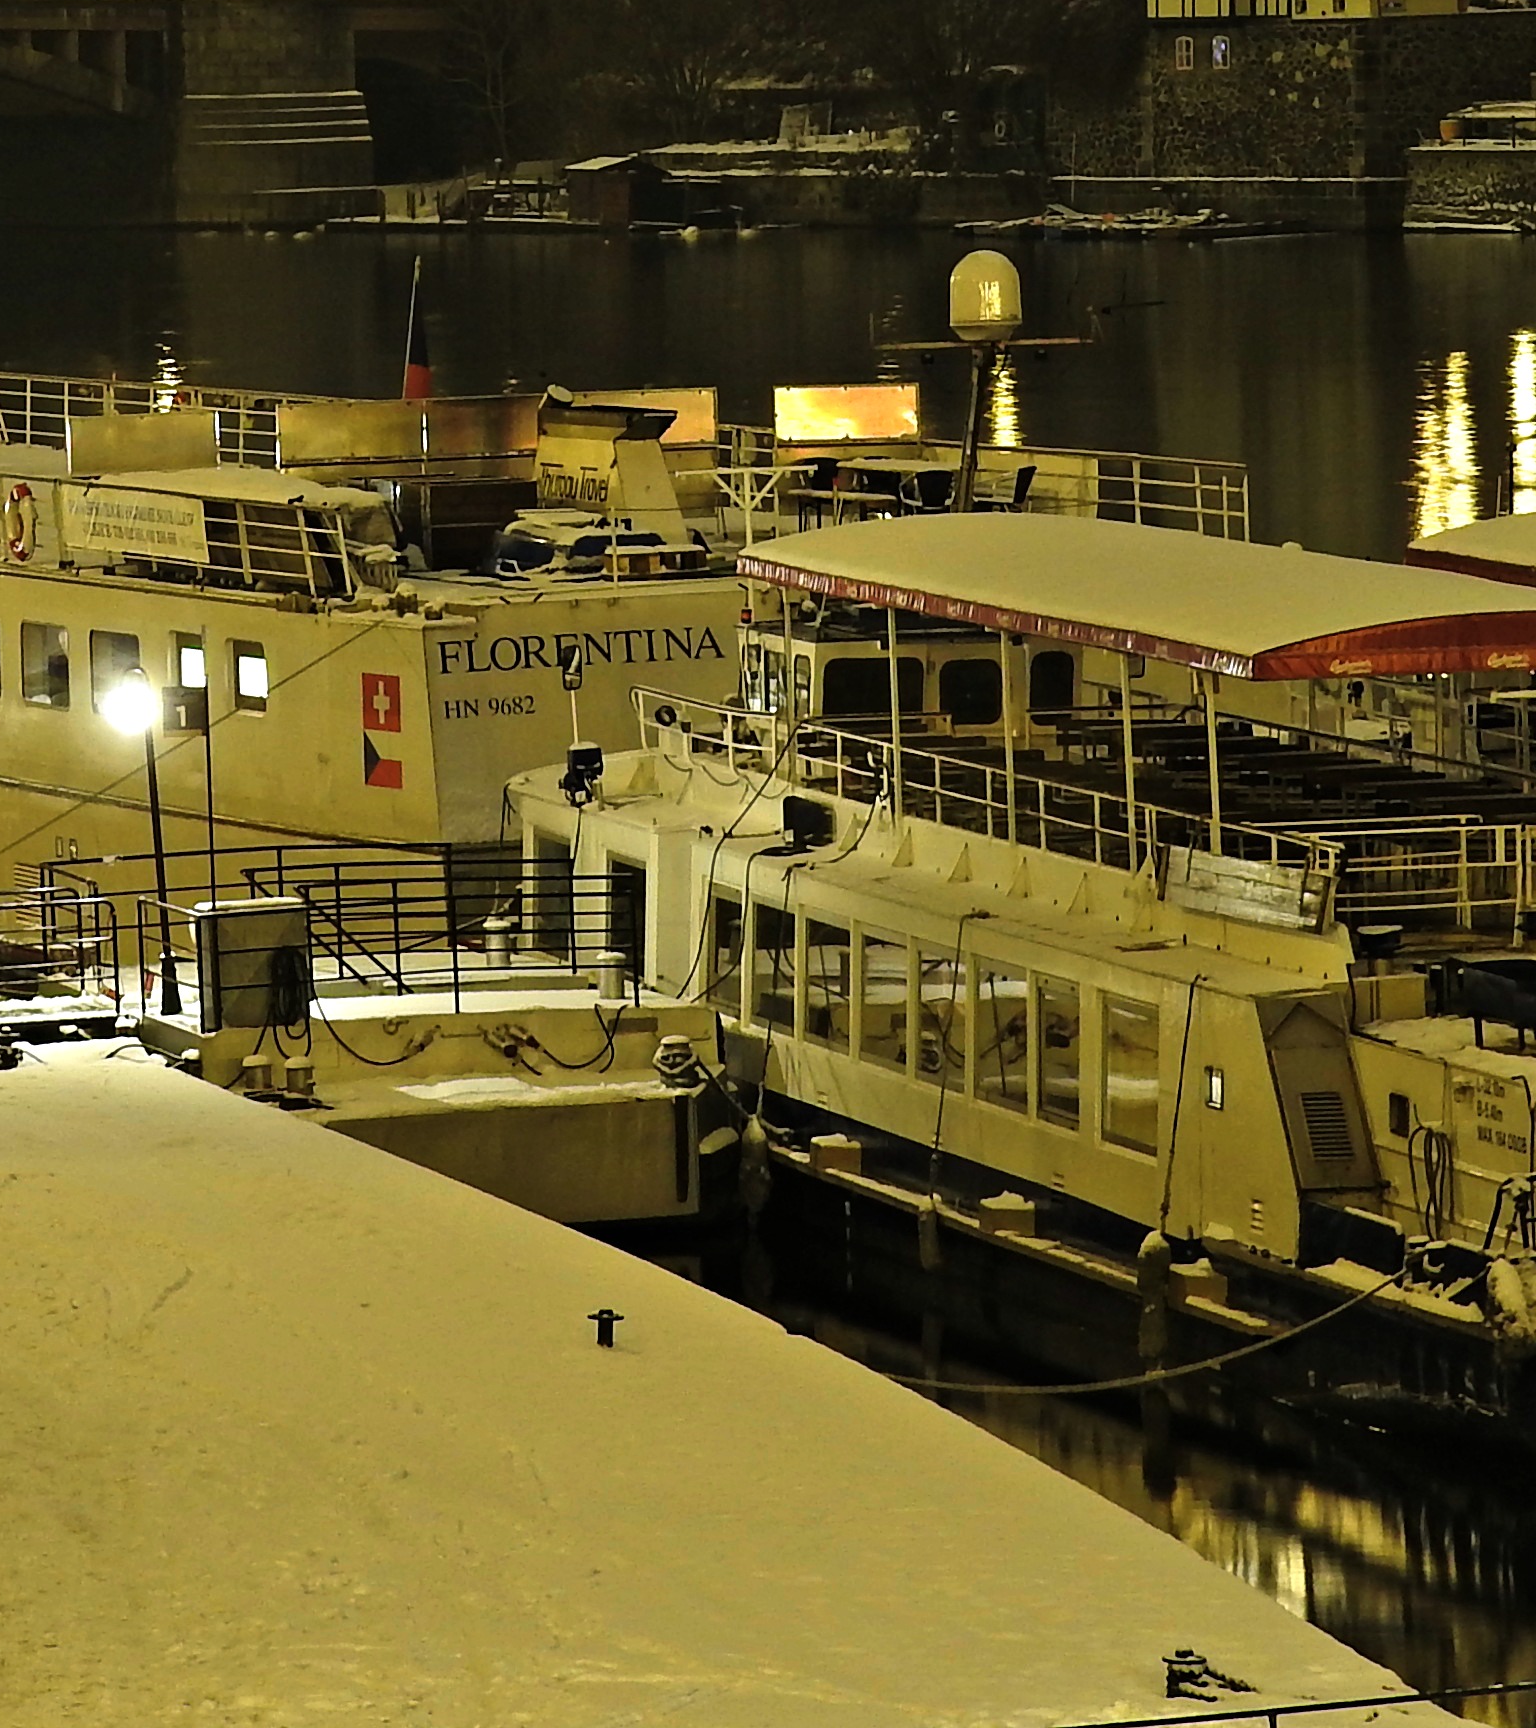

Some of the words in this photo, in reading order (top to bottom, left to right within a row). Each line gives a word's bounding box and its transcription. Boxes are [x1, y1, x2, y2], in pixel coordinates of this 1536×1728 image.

[579, 466, 610, 503] Travel
[438, 626, 724, 674] FLORENTINA
[175, 705, 186, 728] 1
[443, 698, 479, 719] HN
[488, 695, 536, 717] 9682
